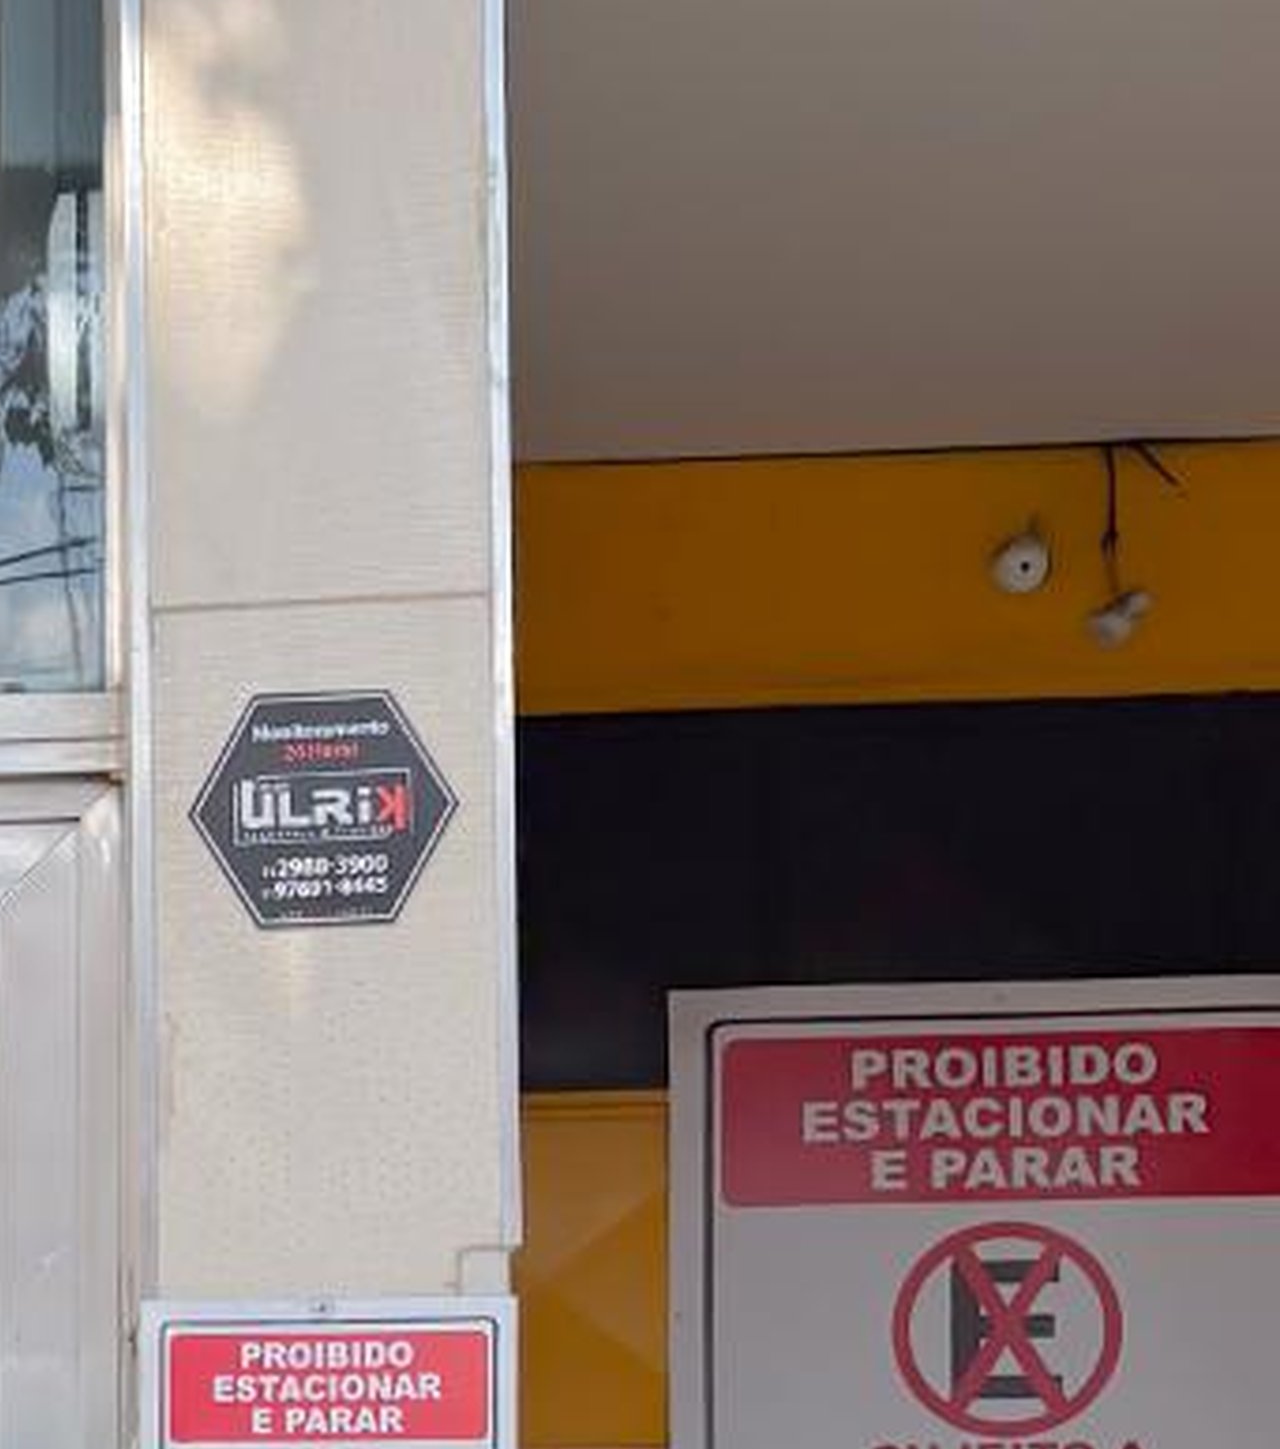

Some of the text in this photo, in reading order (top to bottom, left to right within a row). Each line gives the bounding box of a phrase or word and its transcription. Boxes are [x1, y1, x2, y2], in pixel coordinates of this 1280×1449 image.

[850, 1042, 1158, 1091] PROIBIDO
[800, 1092, 1210, 1144] ESTACIONAR
[871, 1145, 1141, 1190] E PARAR
[240, 1341, 412, 1370] PROIBIDO
[213, 1375, 442, 1402] ESTACIONAR
[252, 1408, 404, 1434] E PARAR
